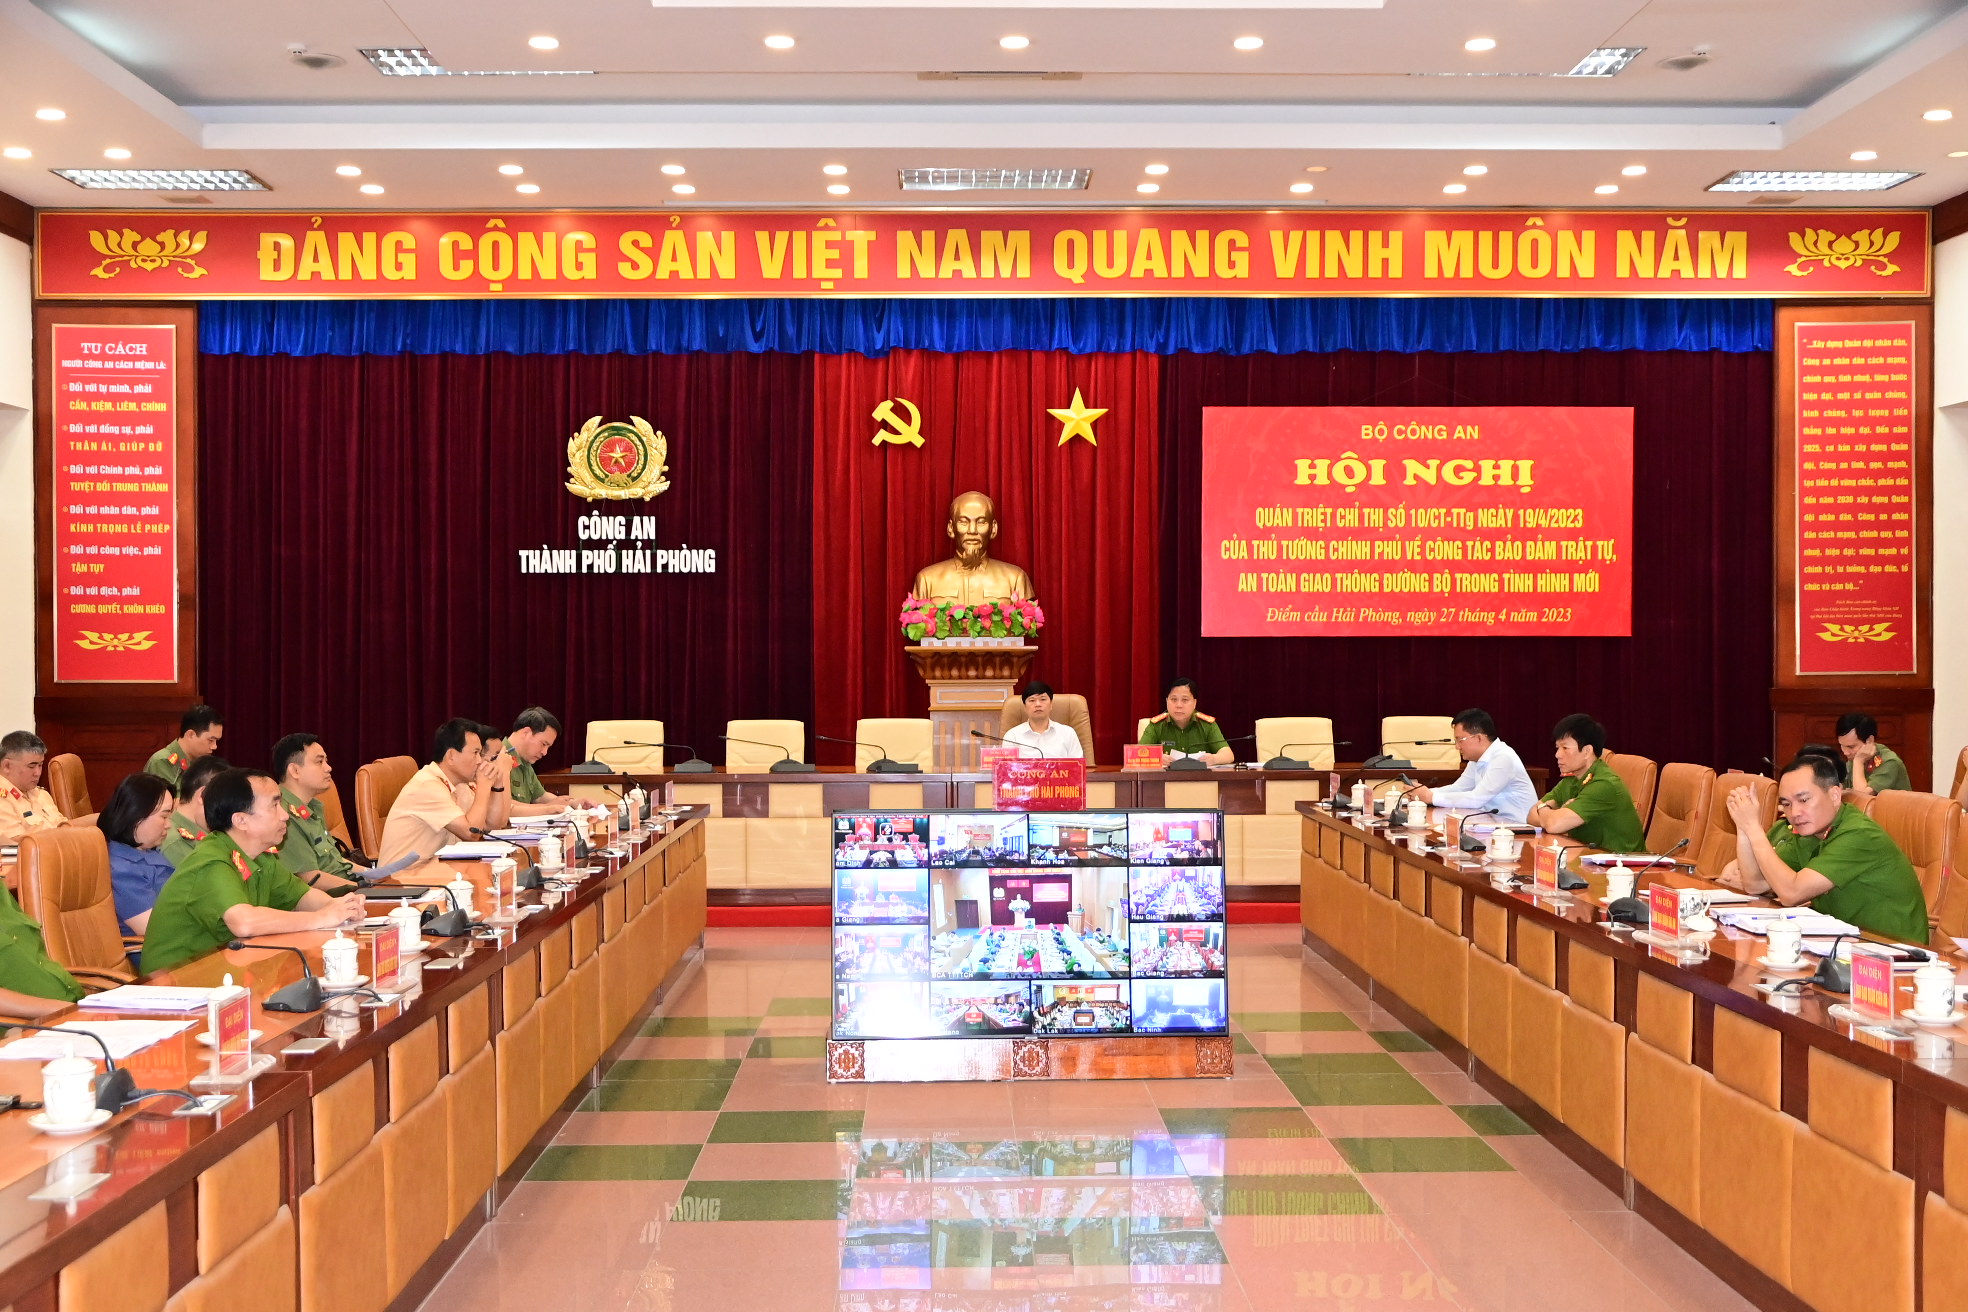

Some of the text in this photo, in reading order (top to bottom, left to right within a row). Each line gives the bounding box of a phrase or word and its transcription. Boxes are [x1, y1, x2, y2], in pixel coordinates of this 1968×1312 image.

[257, 216, 1746, 291] ĐẢNG CỘNG SẢN VIỆT NAM QUANG VINH MUÔN NĂM
[1361, 421, 1479, 442] BỘ CÔNG AN
[1294, 451, 1534, 493] HỘI NGHỊ
[578, 510, 656, 540] CÔNG AN
[1256, 502, 1583, 532] QUÁN TRIỆT CHỈ THỊ SỐ 10/CT-TTg NGÀY 19/4/2023
[519, 541, 716, 573] THÀNH PHỐ HẢI PHÒNG
[1221, 534, 1616, 564] CỦA THỦ TƯỚNG CHÍNH PHỦ VỀ CÔNG TÁC BẢO ĐẢM TRẬT TỰ,
[1238, 568, 1599, 597] AN TOÀN GIAO THÔNG ĐƯỜNG BỘ TRONG TÌNH HÌNH MỚI
[1266, 604, 1572, 625] Điểm cầu Hải Phòng, ngày 27 tháng 4 năm 2023
[1050, 770, 1069, 778] AN
[1041, 781, 1053, 798] HẢI
[1055, 784, 1080, 798] PHÒNG
